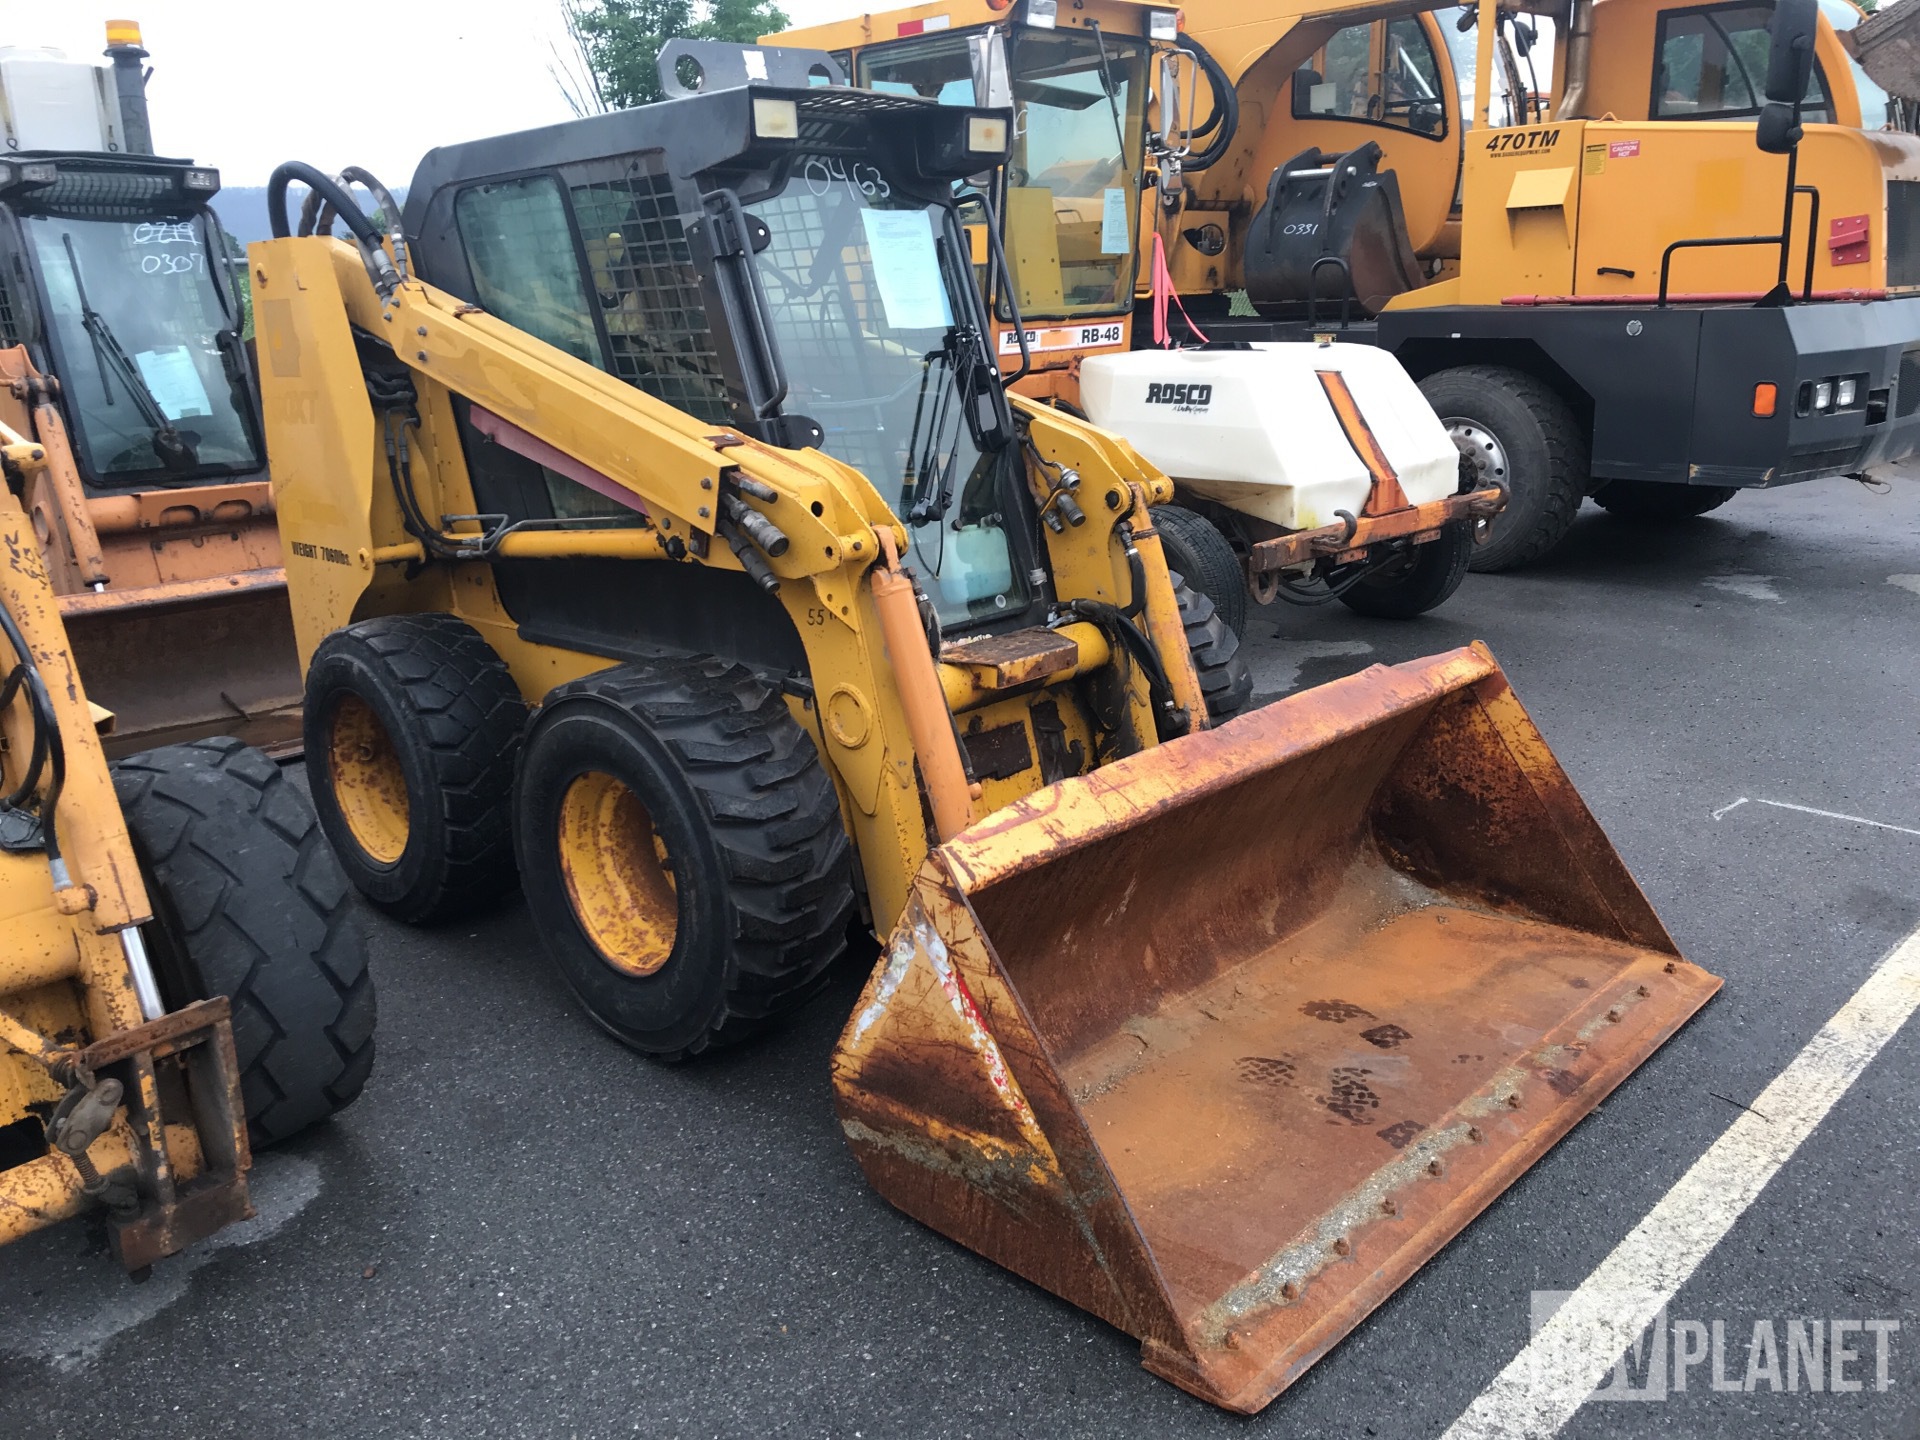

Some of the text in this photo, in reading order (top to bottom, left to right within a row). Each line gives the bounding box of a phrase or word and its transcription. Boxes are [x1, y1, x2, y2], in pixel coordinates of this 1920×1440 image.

[1486, 130, 1560, 151] 470TM
[805, 157, 890, 201] 0463
[142, 253, 204, 274] 0307
[1006, 326, 1120, 345] ROCO RB-48
[1145, 383, 1212, 405] ROSCO
[291, 541, 318, 560] WEIGHT
